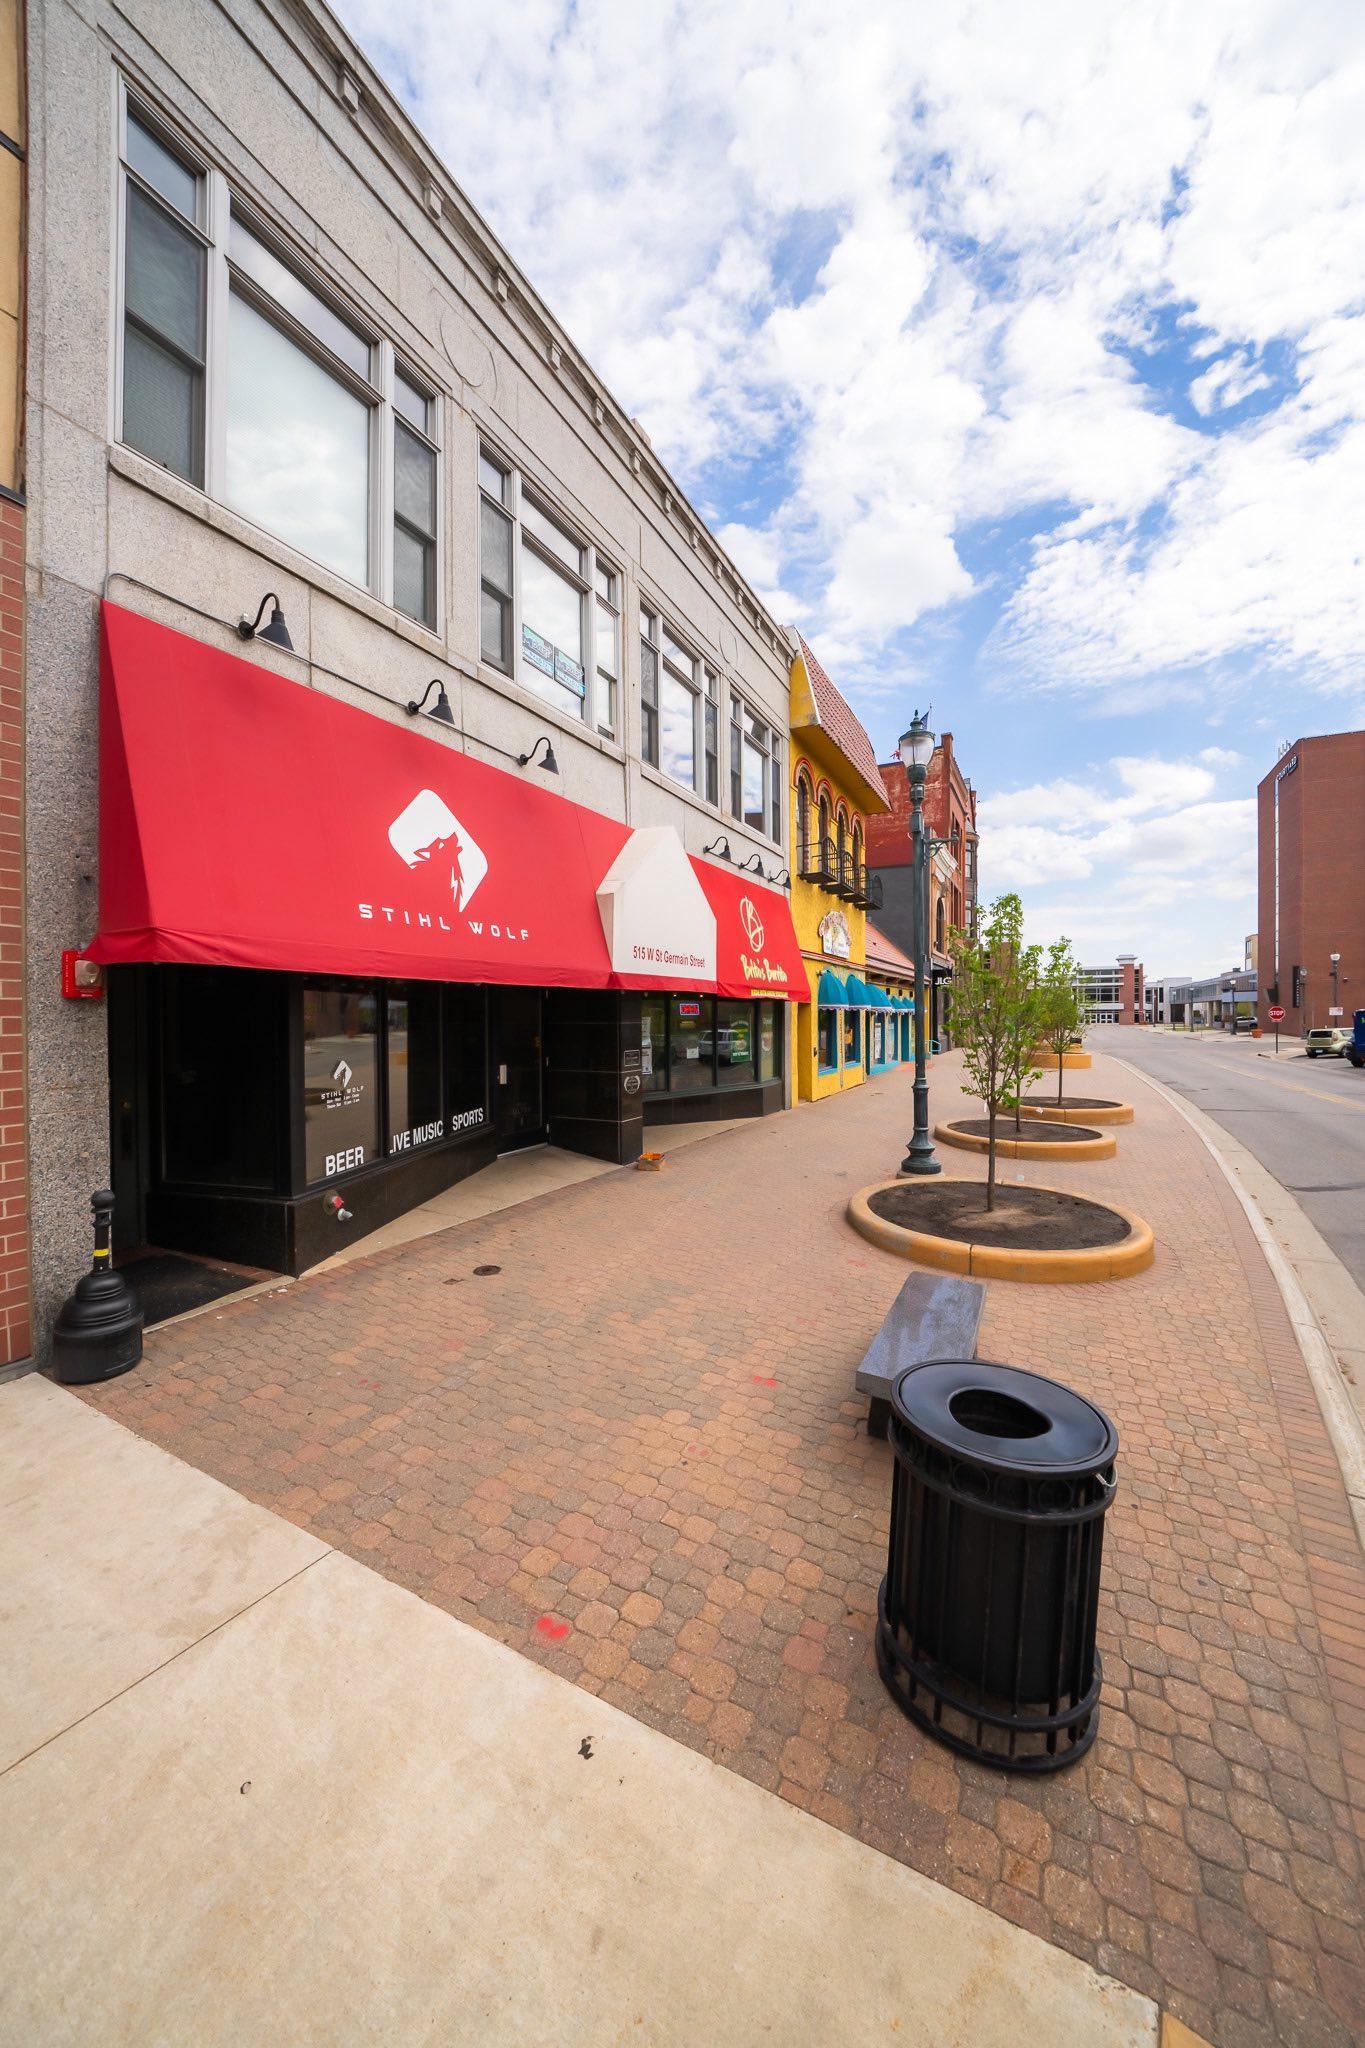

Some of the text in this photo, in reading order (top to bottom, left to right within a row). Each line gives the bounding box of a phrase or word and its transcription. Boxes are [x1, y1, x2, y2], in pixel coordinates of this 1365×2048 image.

[358, 903, 529, 941] STIHL WOLF
[633, 945, 705, 967] 515 W St Germain Street
[321, 1091, 342, 1099] STIHL
[452, 1107, 484, 1131] SPORTS
[413, 1120, 444, 1146] MUSIC
[325, 1145, 365, 1177] BEER
